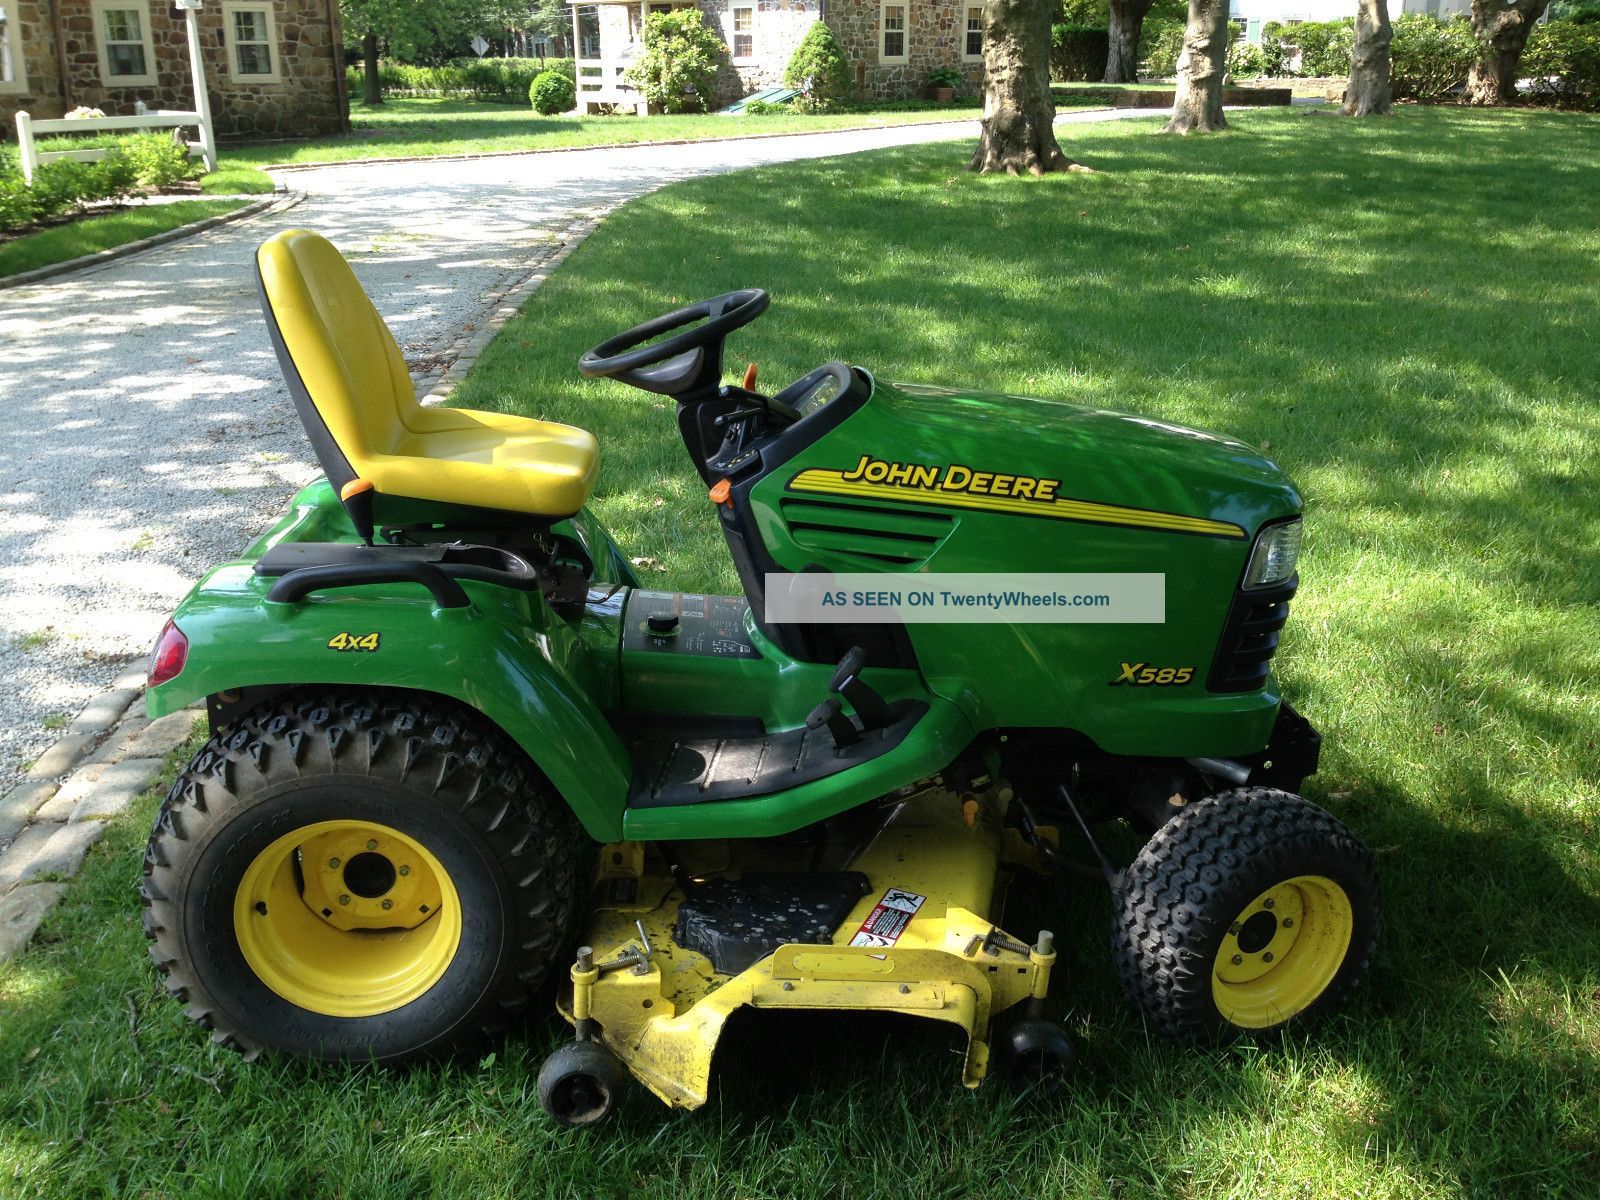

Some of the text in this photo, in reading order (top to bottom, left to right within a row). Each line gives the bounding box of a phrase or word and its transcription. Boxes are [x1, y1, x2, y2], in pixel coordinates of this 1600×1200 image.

[843, 455, 1060, 500] JOHN DEERE
[327, 631, 380, 651] 4x4
[1113, 662, 1195, 685] X585
